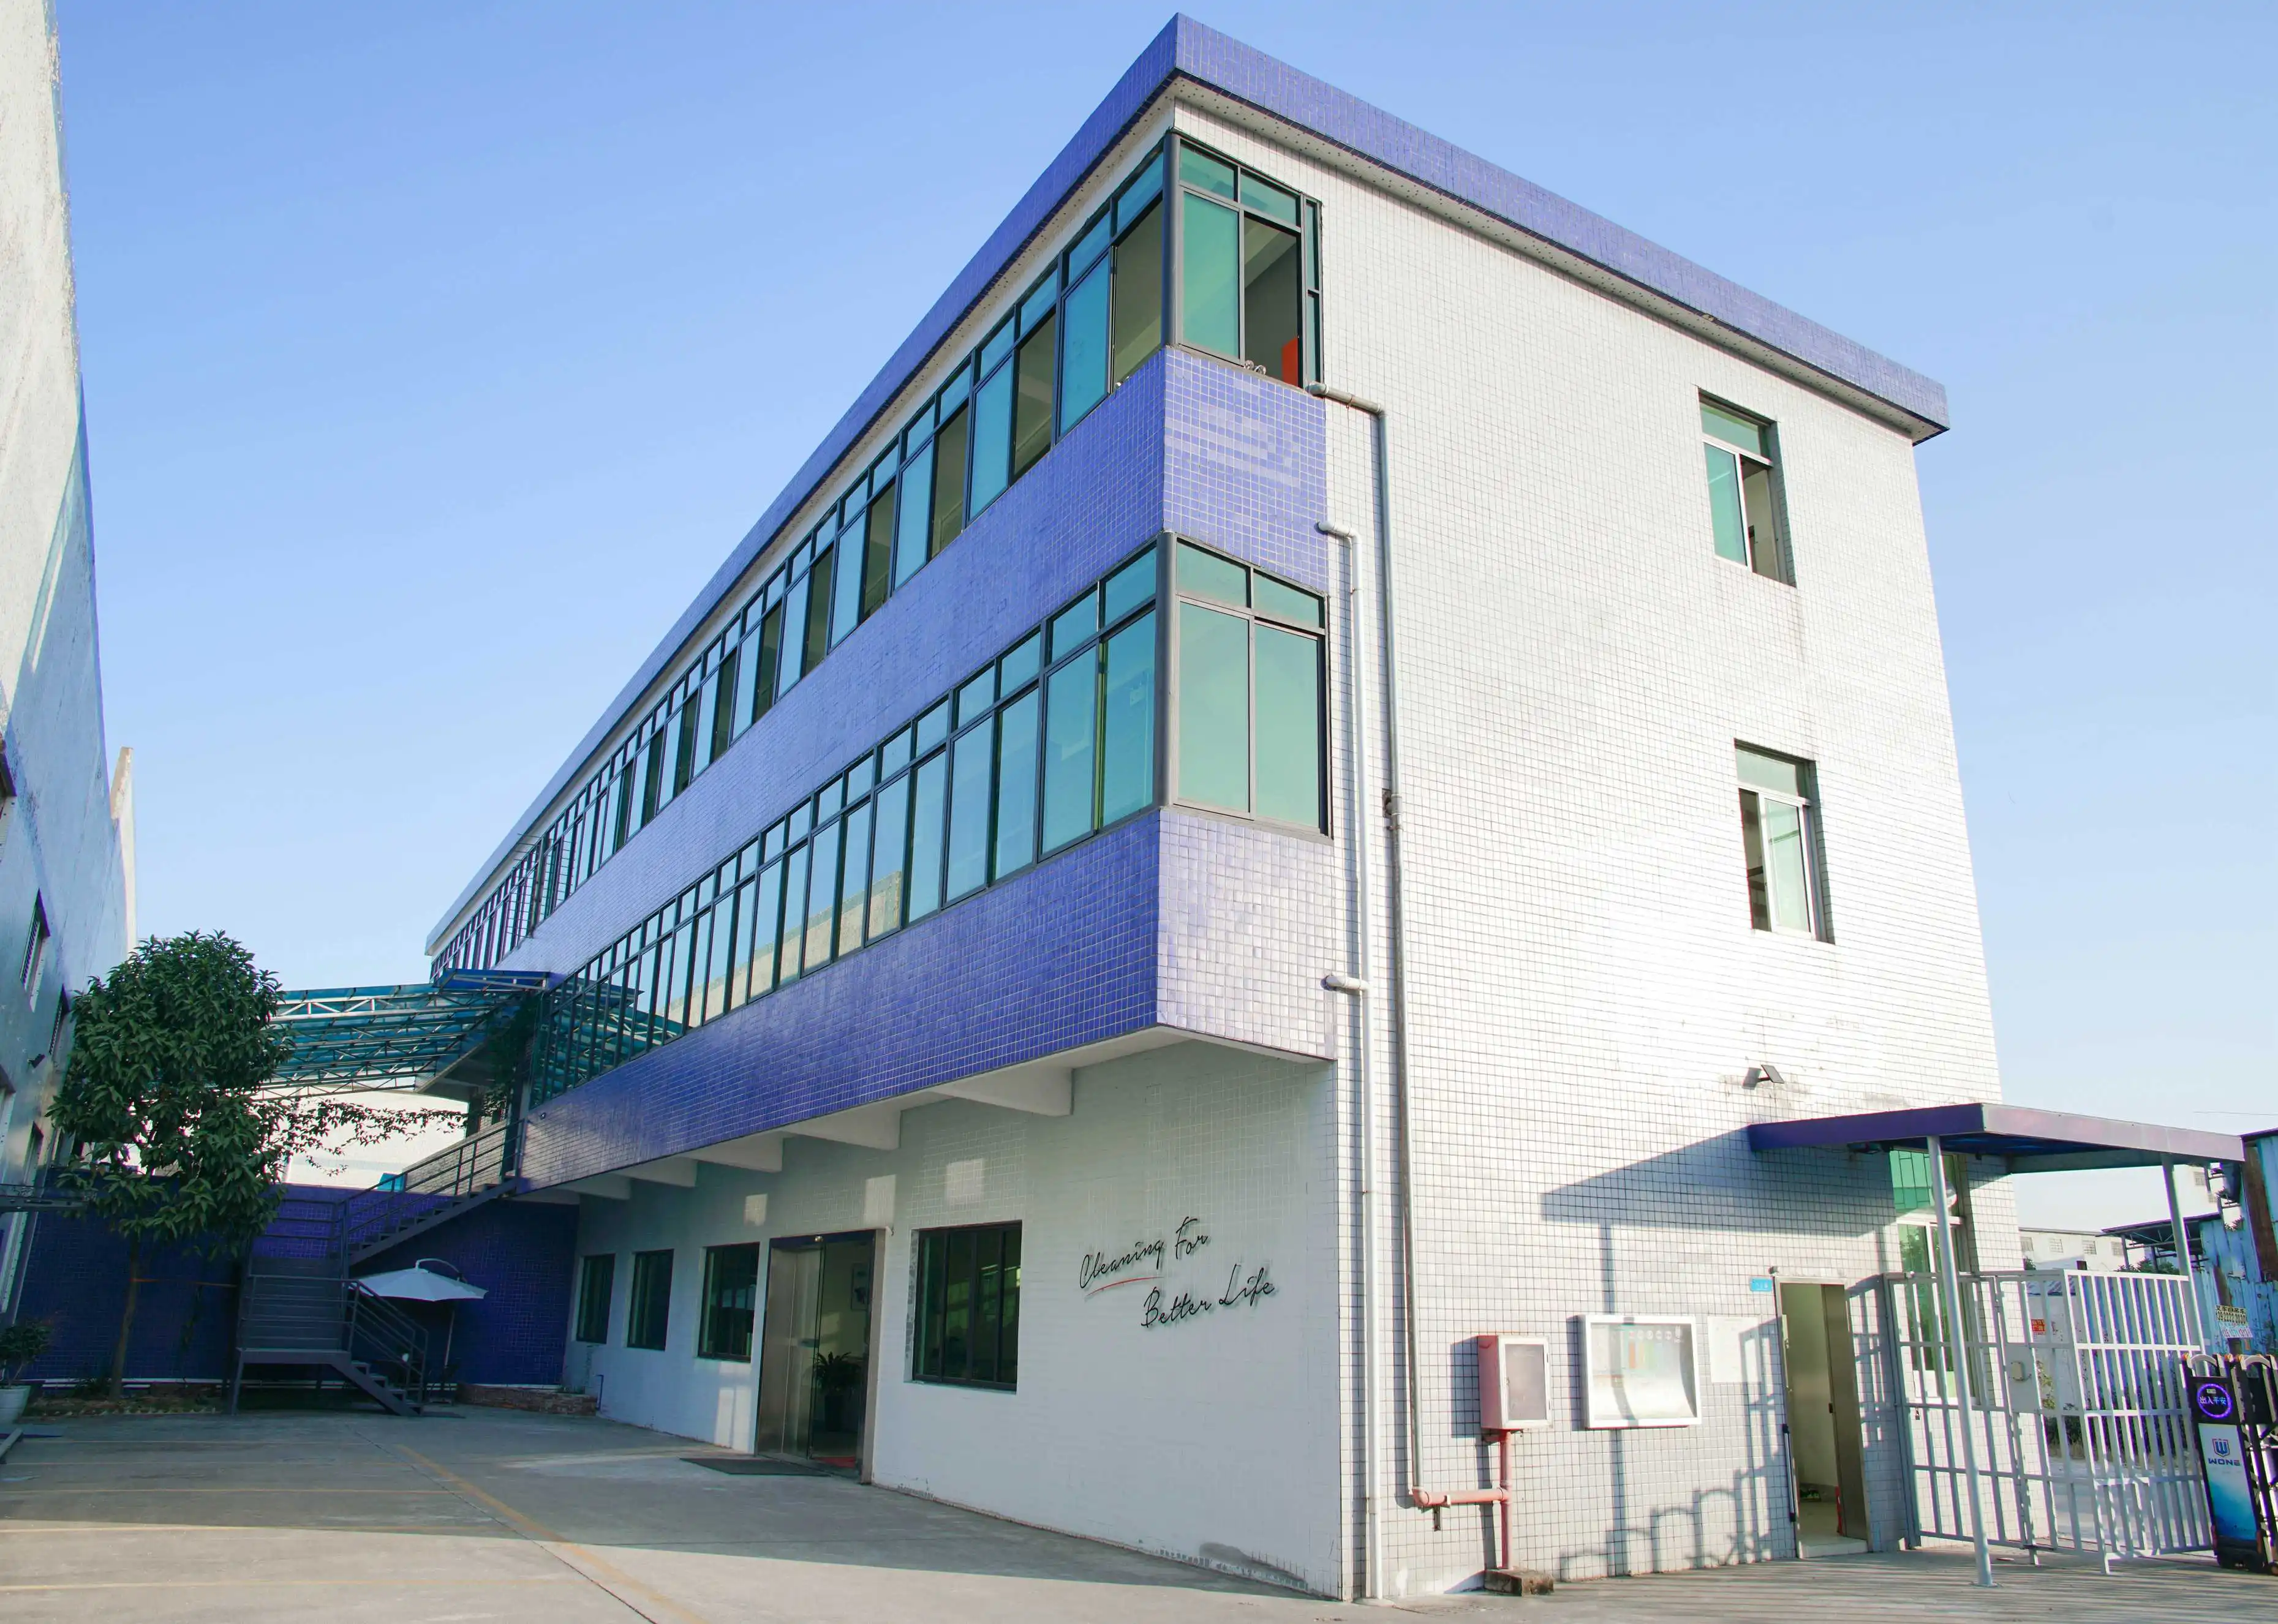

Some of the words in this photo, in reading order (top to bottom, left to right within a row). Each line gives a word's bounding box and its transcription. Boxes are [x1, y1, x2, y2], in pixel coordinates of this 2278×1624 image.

[1080, 1240, 1164, 1289] Cleaning
[1175, 1216, 1210, 1260] For
[1141, 1287, 1212, 1328] Better
[1219, 1263, 1275, 1307] Life
[2200, 1396, 2227, 1405] 出入平安
